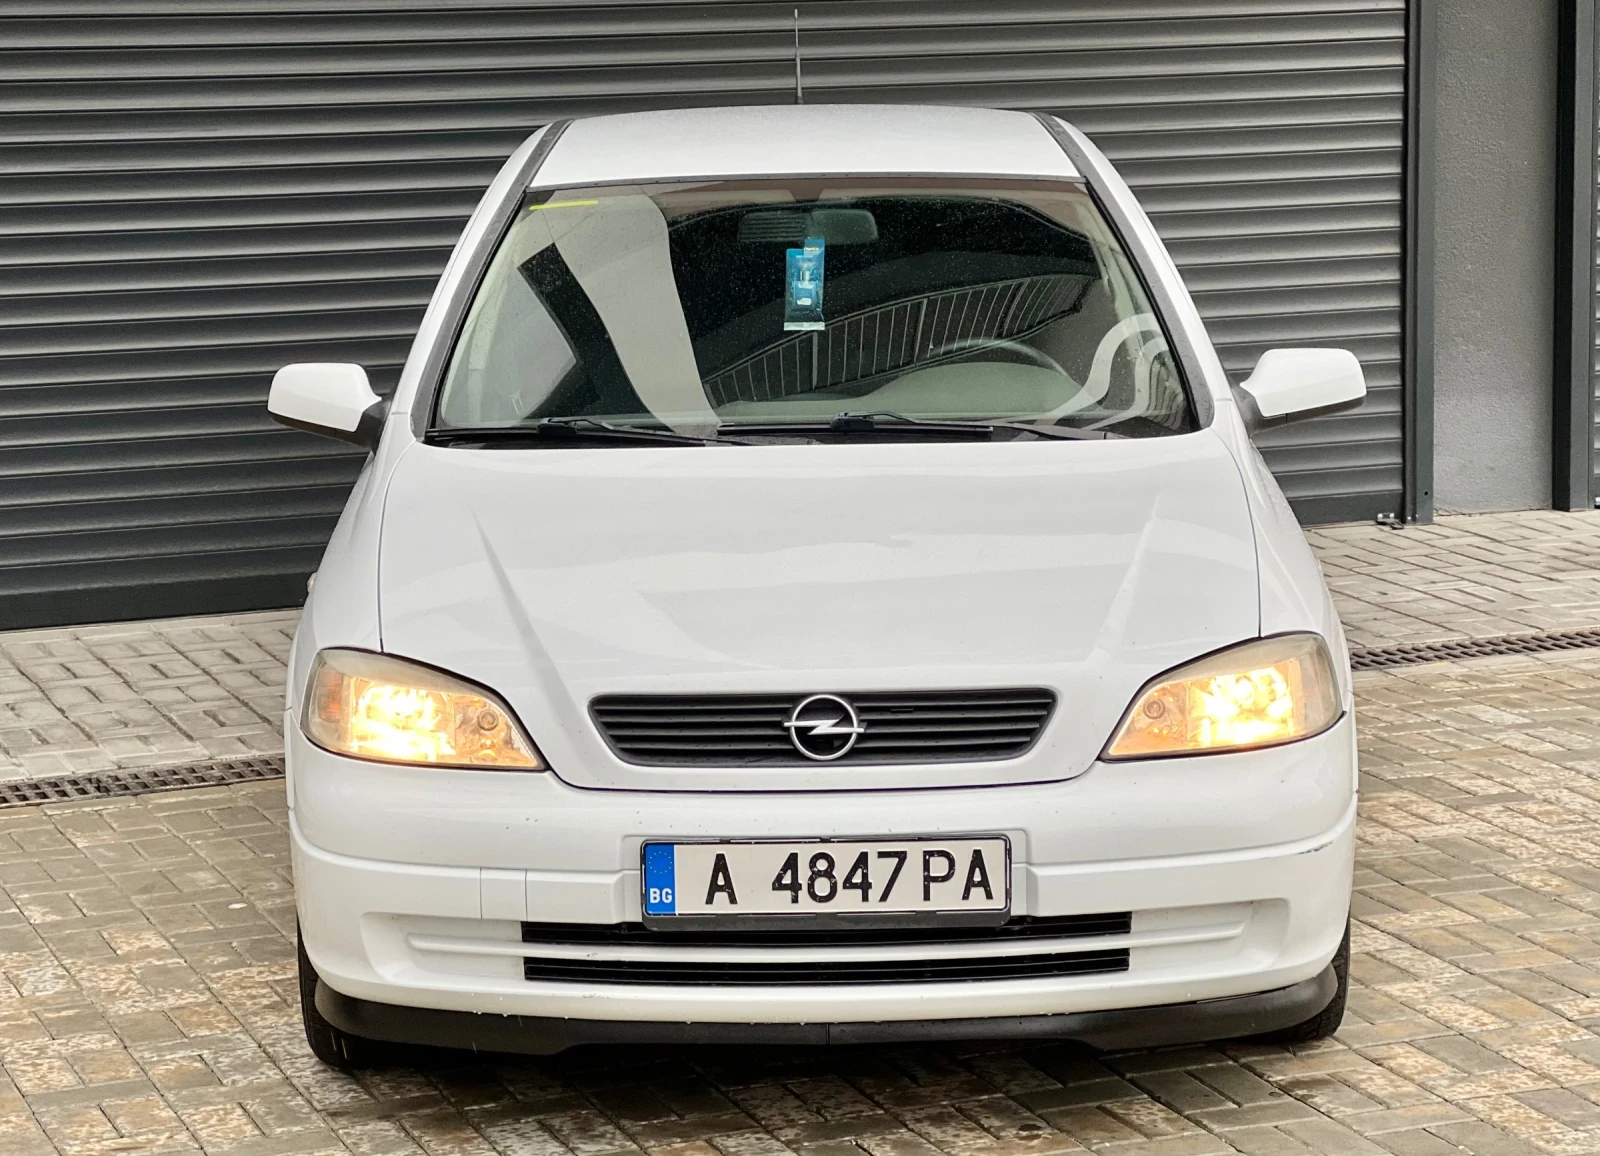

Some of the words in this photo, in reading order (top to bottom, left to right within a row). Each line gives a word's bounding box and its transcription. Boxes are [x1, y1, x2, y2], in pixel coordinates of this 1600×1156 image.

[705, 853, 738, 905] A
[772, 850, 908, 904] 4847
[923, 849, 994, 902] PA
[649, 887, 673, 904] BG
